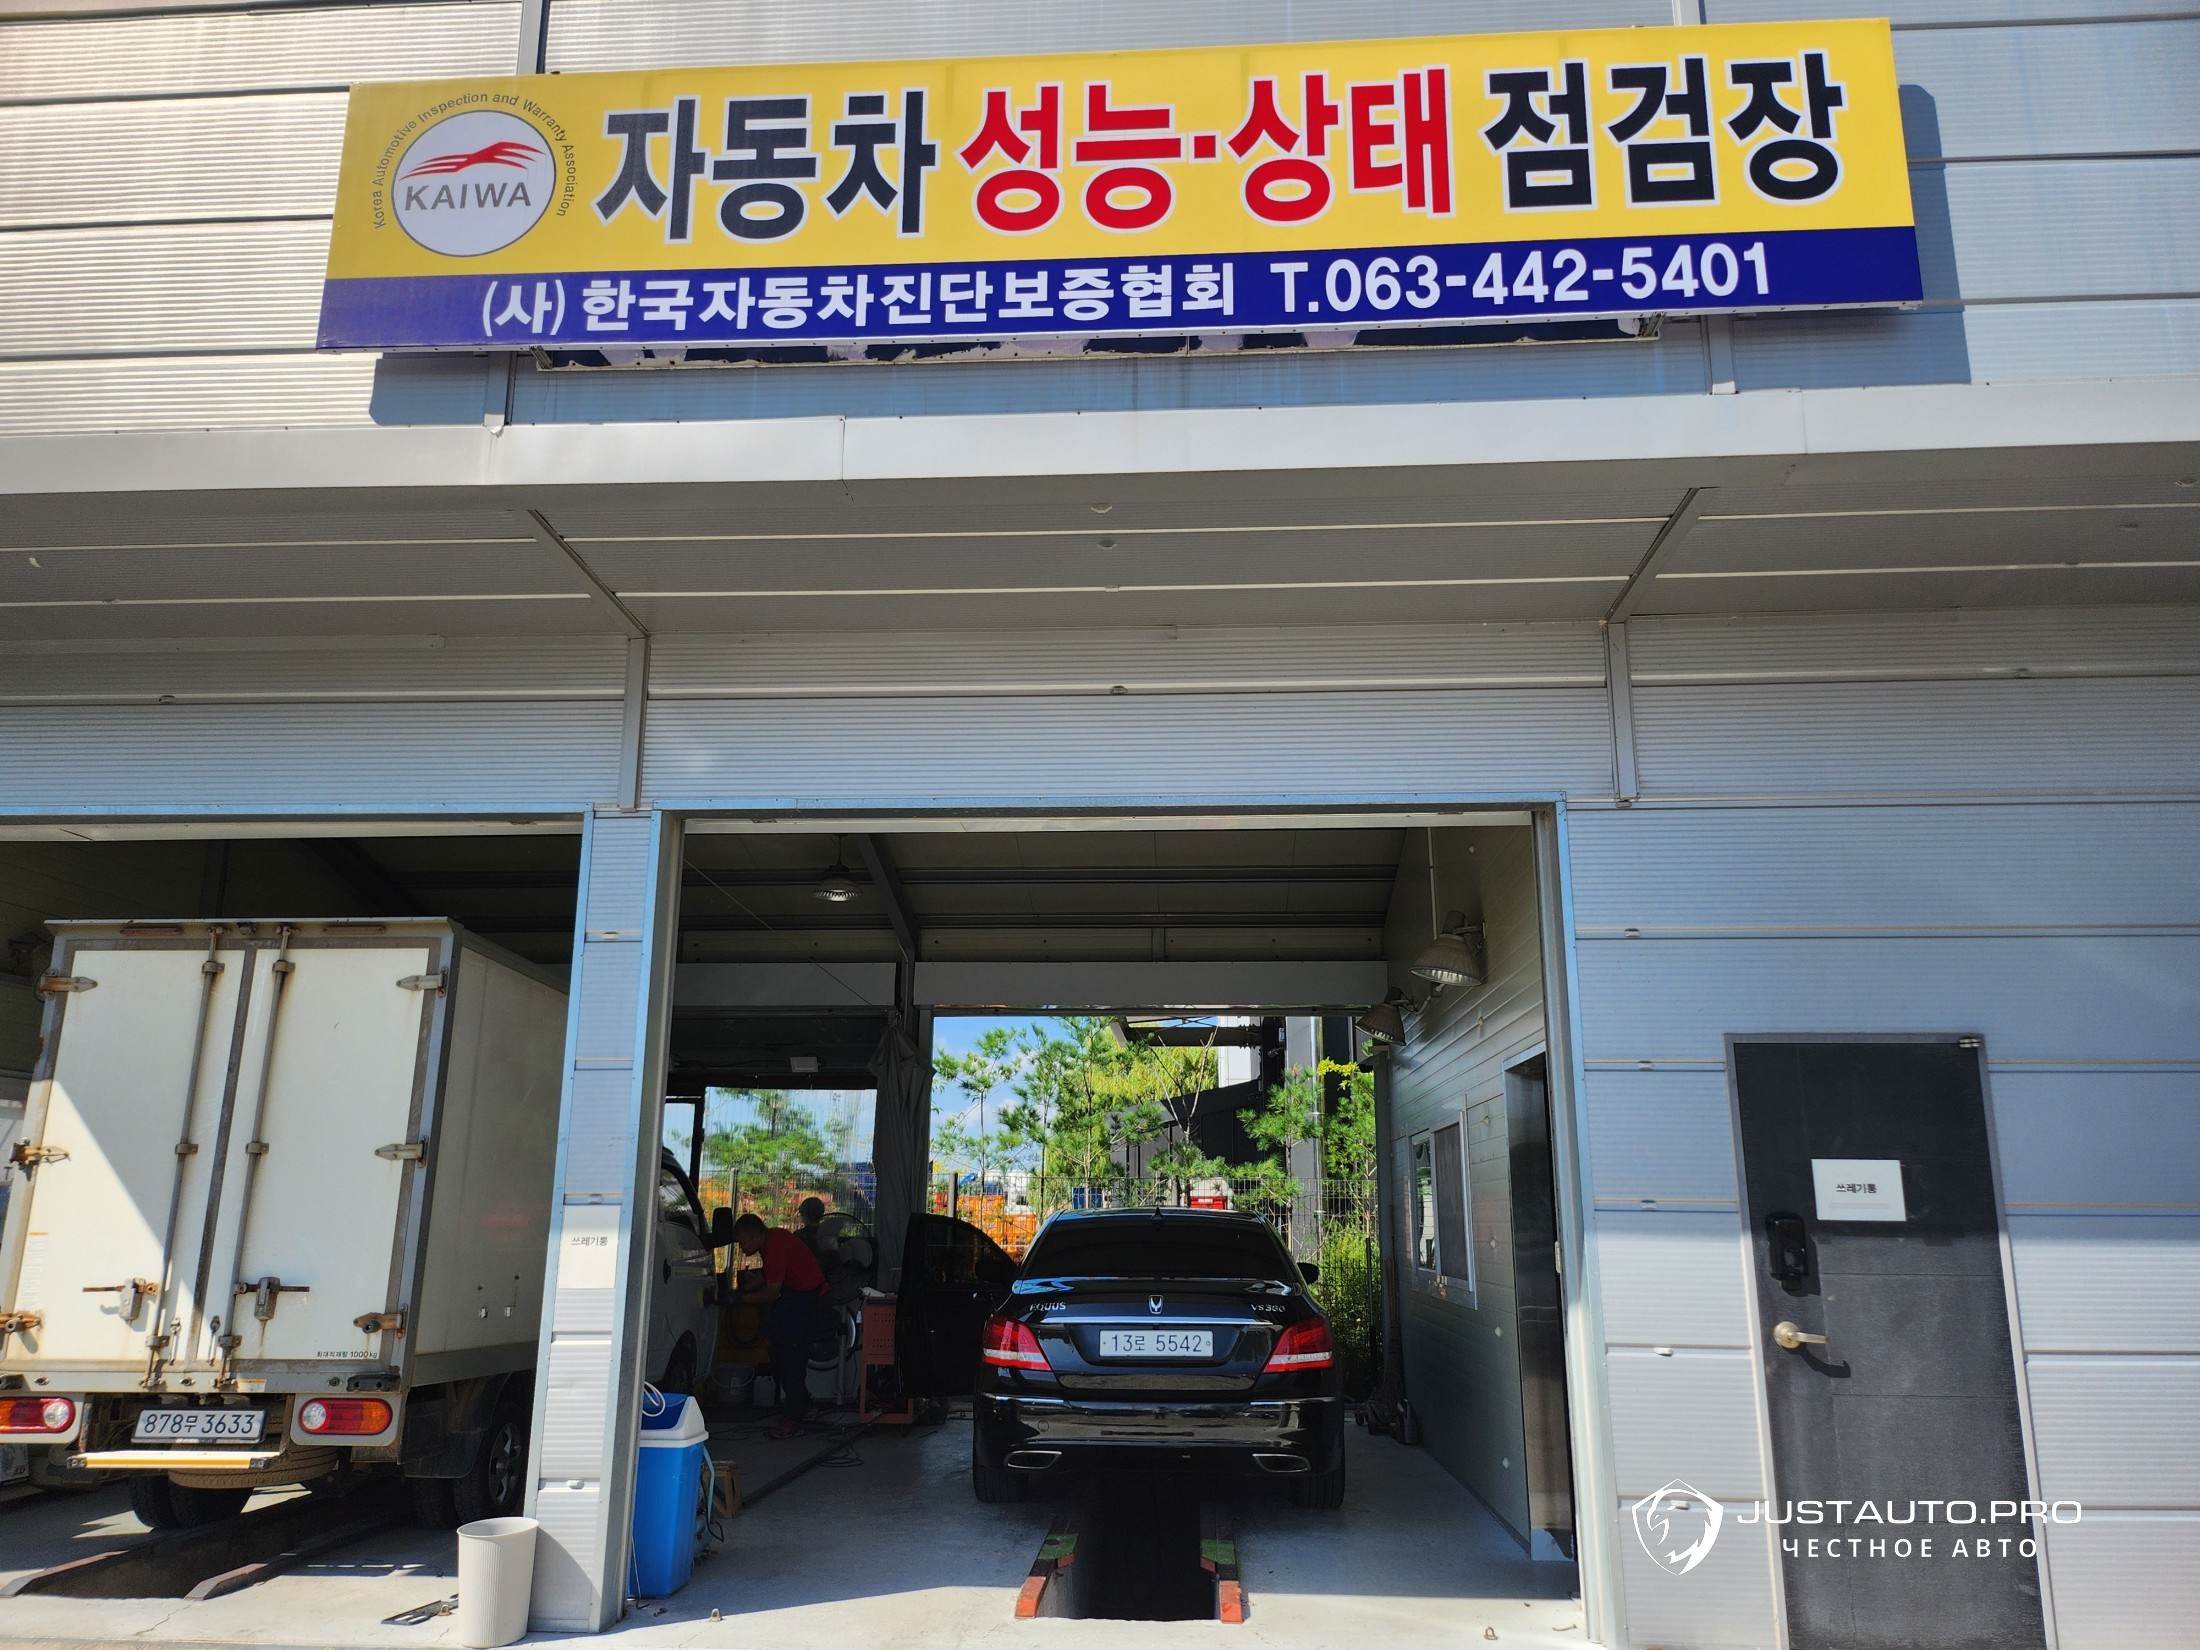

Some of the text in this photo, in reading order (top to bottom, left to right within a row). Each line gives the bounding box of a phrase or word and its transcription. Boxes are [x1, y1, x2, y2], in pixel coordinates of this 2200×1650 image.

[596, 88, 938, 242] 자동차
[1483, 52, 1844, 209] 점검장
[372, 93, 579, 229] Korea Automotive Inspection and Warranty Association
[404, 181, 532, 211] KAIWA
[482, 241, 1770, 337] (사) 한국자동차진단보증협회 T.063-442-5401
[1836, 1183, 1877, 1194] 쓰레기통
[571, 1236, 608, 1247] 쓰레기통
[1112, 1334, 1202, 1352] 13로 5542
[144, 1413, 256, 1434] 878무 3633
